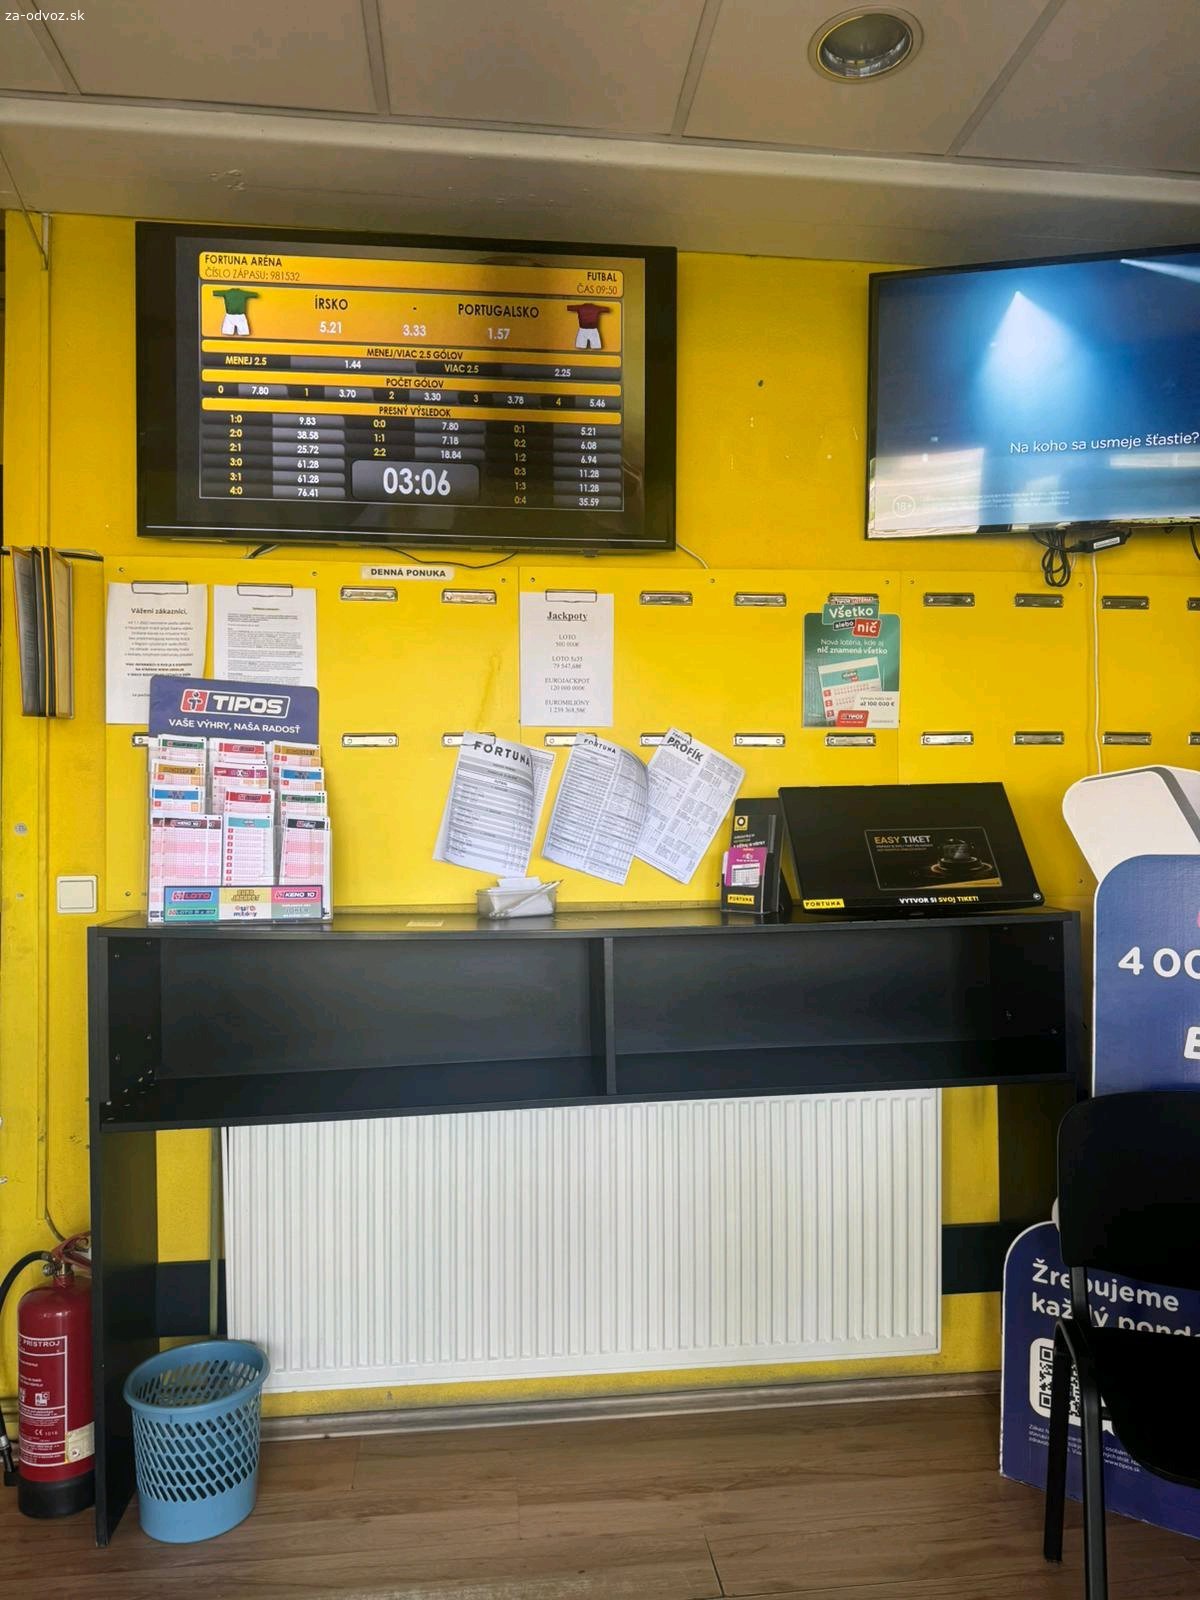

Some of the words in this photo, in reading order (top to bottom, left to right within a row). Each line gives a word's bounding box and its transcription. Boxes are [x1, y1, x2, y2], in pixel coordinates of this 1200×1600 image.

[205, 255, 248, 266] FORTUNA
[251, 255, 282, 267] ARÉNA
[205, 266, 231, 278] ČÍSLO
[233, 267, 269, 280] ZÁPASU:
[270, 269, 300, 282] 981532
[587, 271, 617, 282] FUTBAL
[576, 283, 596, 294] ČAS
[597, 284, 618, 295] 09:50
[315, 294, 348, 311] ÍRSKO
[457, 303, 539, 318] PORTUGALSKO
[319, 321, 342, 334] 5.21
[402, 324, 427, 337] 3.33
[487, 328, 511, 340] 1.57
[366, 348, 418, 359] MENEJ/VIAC
[419, 349, 432, 359] 2.5
[433, 349, 463, 360] GÓLOV
[225, 355, 253, 366] MENEJ
[254, 356, 267, 366] 2.5
[344, 360, 361, 369] 1.44
[444, 363, 465, 374] VIAC
[466, 364, 479, 374] 2.5
[554, 368, 571, 377] 2.25
[385, 376, 412, 388] POČET
[413, 377, 444, 389] GÓLOV
[217, 385, 224, 394] 0
[251, 386, 269, 395] 7.80
[304, 388, 310, 397] 1
[339, 389, 357, 398] 3.70
[388, 391, 395, 400] 2
[423, 391, 442, 401] 3.30
[473, 394, 479, 403] 3
[507, 395, 525, 405] 3.78
[555, 397, 561, 406] 4
[589, 398, 606, 408] 5.46
[378, 404, 408, 415] PRESNÝ
[410, 404, 451, 417] VÝSLEDOK
[229, 414, 243, 424] 1:0
[373, 419, 386, 428] 0:0
[441, 421, 459, 431] 7.80
[513, 424, 526, 433] 0:1
[229, 429, 243, 438] 2:0
[580, 427, 596, 436] 5.21
[374, 434, 386, 443] 1:1
[441, 436, 459, 445] 7.18
[513, 439, 527, 448] 0:2
[1010, 441, 1030, 454] Na
[1032, 439, 1068, 453] koho
[1072, 440, 1087, 451] sa
[1090, 436, 1142, 451] usmeje
[1145, 431, 1200, 448] šťastie?
[229, 443, 242, 453] 2:1
[297, 445, 319, 454] 25.72
[580, 441, 597, 450] 6.08
[373, 448, 386, 457] 2:2
[440, 450, 462, 459] 18.84
[514, 453, 527, 462] 1:2
[229, 457, 243, 467] 3:0
[297, 460, 319, 469] 61.28
[229, 472, 242, 481] 3:1
[513, 467, 527, 476] 0:3
[579, 469, 600, 479] 11.28
[297, 474, 319, 484] 61.28
[382, 466, 452, 497] 03:06
[229, 486, 243, 495] 4:0
[514, 482, 527, 491] 1:3
[579, 484, 600, 493] 11.28
[297, 488, 319, 498] 76.41
[513, 496, 527, 505] 0:4
[578, 497, 600, 507] 35.59
[370, 567, 404, 577] DENNÁ
[406, 569, 446, 578] PONUKA
[131, 607, 154, 615] Vážení
[155, 607, 188, 616] zákazníci,
[547, 611, 588, 622] Jackpoty
[829, 605, 874, 619] Všetko
[835, 621, 854, 629] alebo
[857, 621, 878, 634] nič
[817, 646, 829, 654] nič
[830, 646, 862, 655] znamená
[863, 646, 888, 655] všetko
[213, 695, 284, 714] TIPOS
[168, 717, 195, 728] VAŠE
[196, 718, 232, 731] VÝHRY,
[233, 721, 260, 732] NAŠA
[262, 723, 301, 734] RADOSŤ
[583, 738, 616, 754] FORTUNA
[666, 736, 705, 762] PROFÍK
[473, 740, 530, 766] FORTUNA
[874, 836, 900, 845] EASY
[901, 835, 931, 844] TIKET
[184, 891, 211, 900] LOTO
[938, 896, 956, 904] SVOJ
[957, 895, 980, 903] TIKET!
[1118, 945, 1145, 976] 4
[1032, 1257, 1180, 1312] Žreujeme
[1032, 1291, 1109, 1328] kažý
